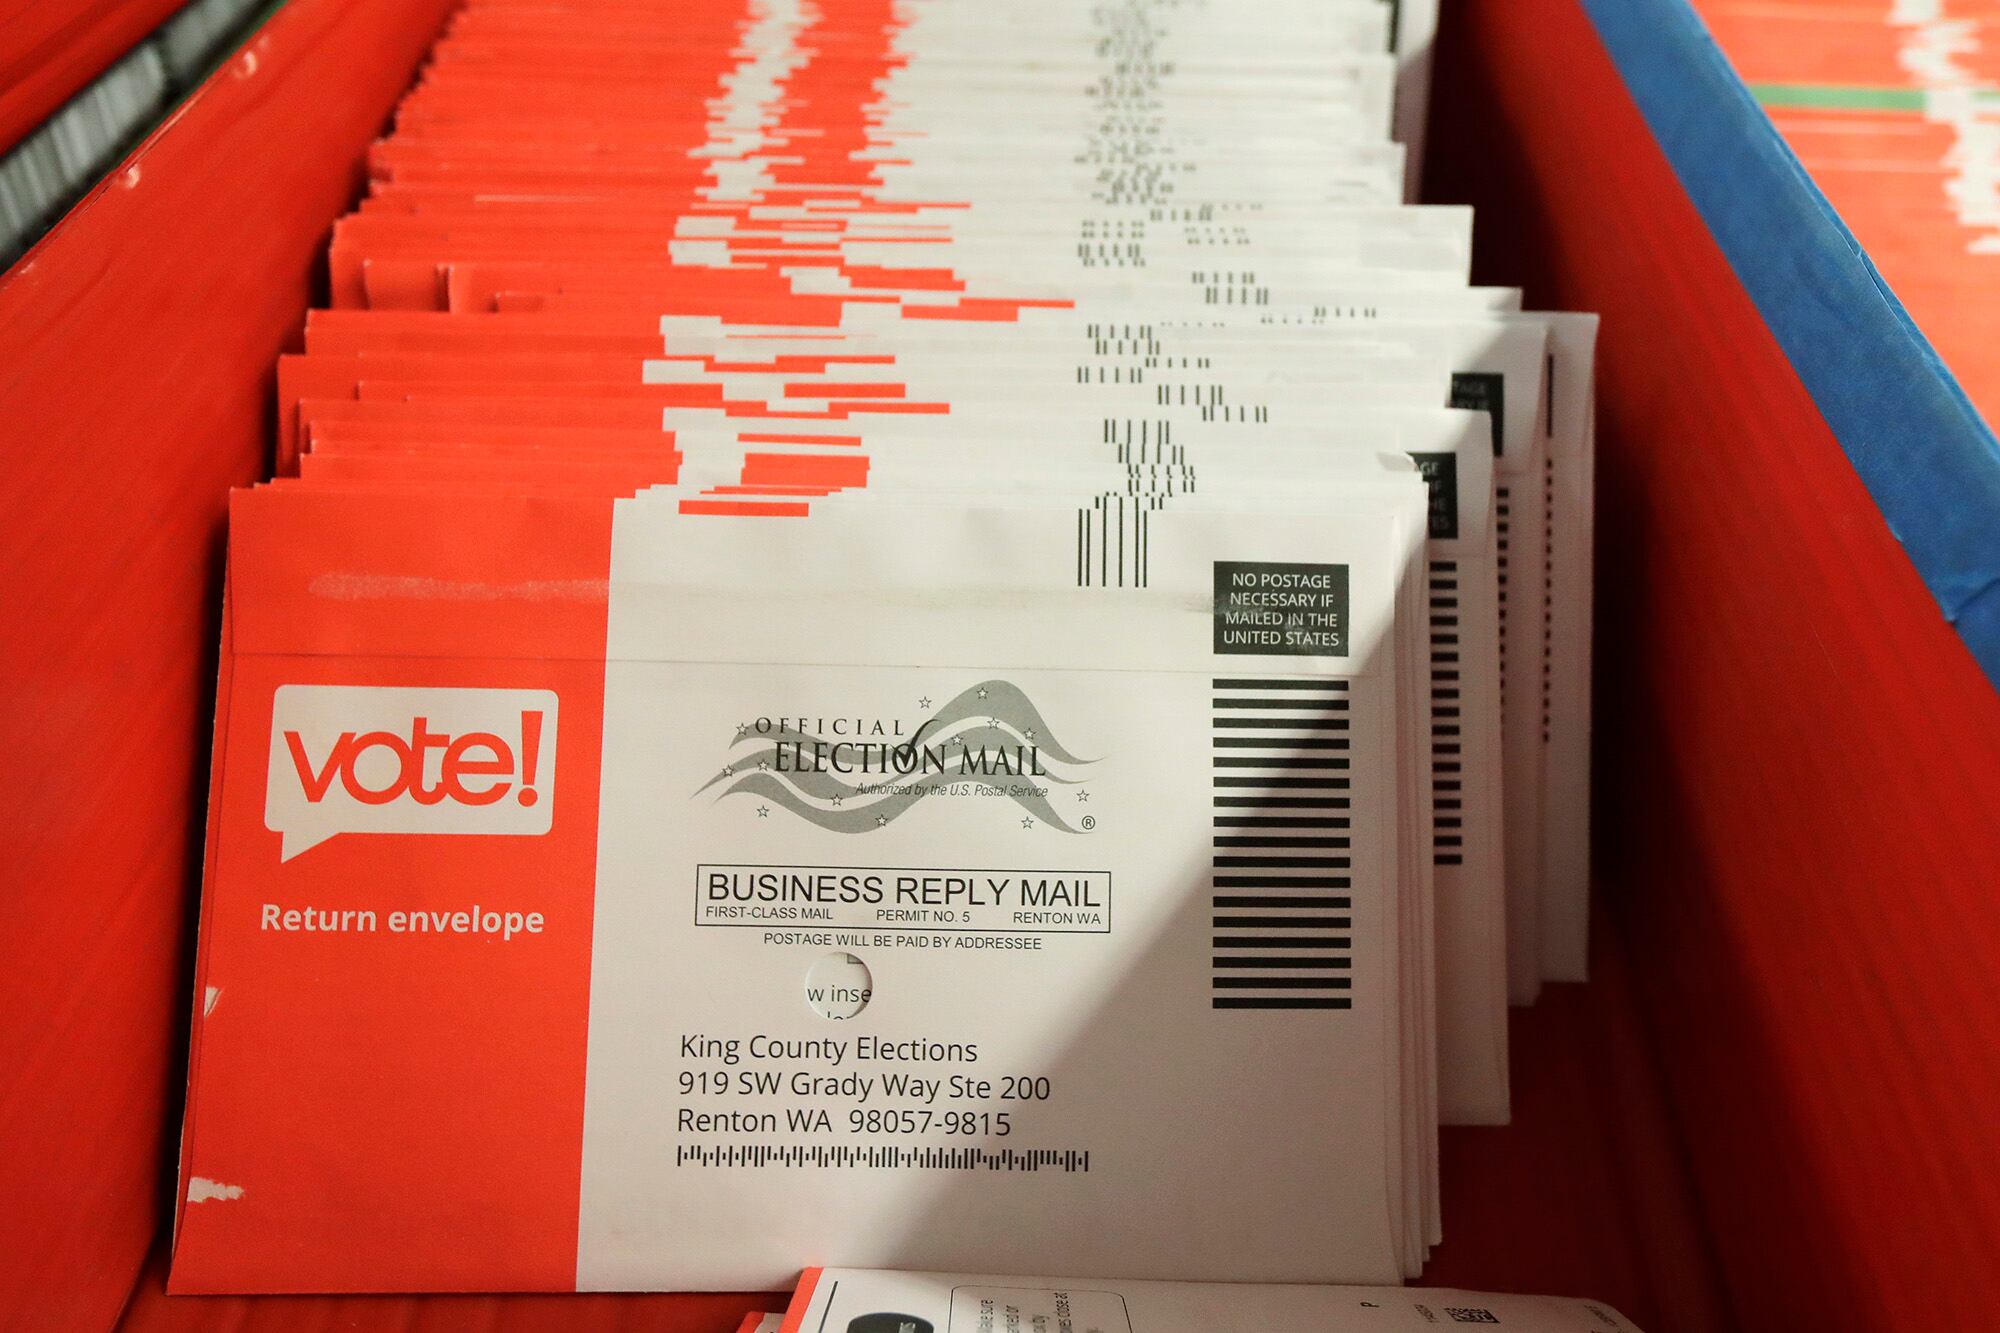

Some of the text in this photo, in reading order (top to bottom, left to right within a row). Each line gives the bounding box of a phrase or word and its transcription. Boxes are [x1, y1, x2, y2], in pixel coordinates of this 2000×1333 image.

[1233, 573, 1331, 588] NO POSTAGE
[1230, 592, 1334, 607] NECESSARY IF
[1225, 611, 1338, 627] MAILED IN THE
[1223, 631, 1340, 646] UNITED STATES
[755, 717, 905, 736] OFFICIAL
[283, 710, 544, 808] vote!
[774, 741, 1046, 777] ELECTION MAIL
[855, 783, 1048, 798] Authorized by the U.S. Postal Service
[709, 873, 1101, 907] BUSINESS REPLY MAIL
[261, 904, 544, 940] Return envelope
[706, 906, 1101, 924] FIRST-CLASS MAIL PERMIT NO. 5 RENTON WA
[764, 933, 1042, 950] POSTAGE WILL BE PAID BY ADDRESSEE
[680, 1034, 978, 1066] King County Elections
[679, 1071, 1051, 1104] 919 SW Grady Way Ste 200
[678, 1108, 1012, 1136] Renton WA 98057-9815
